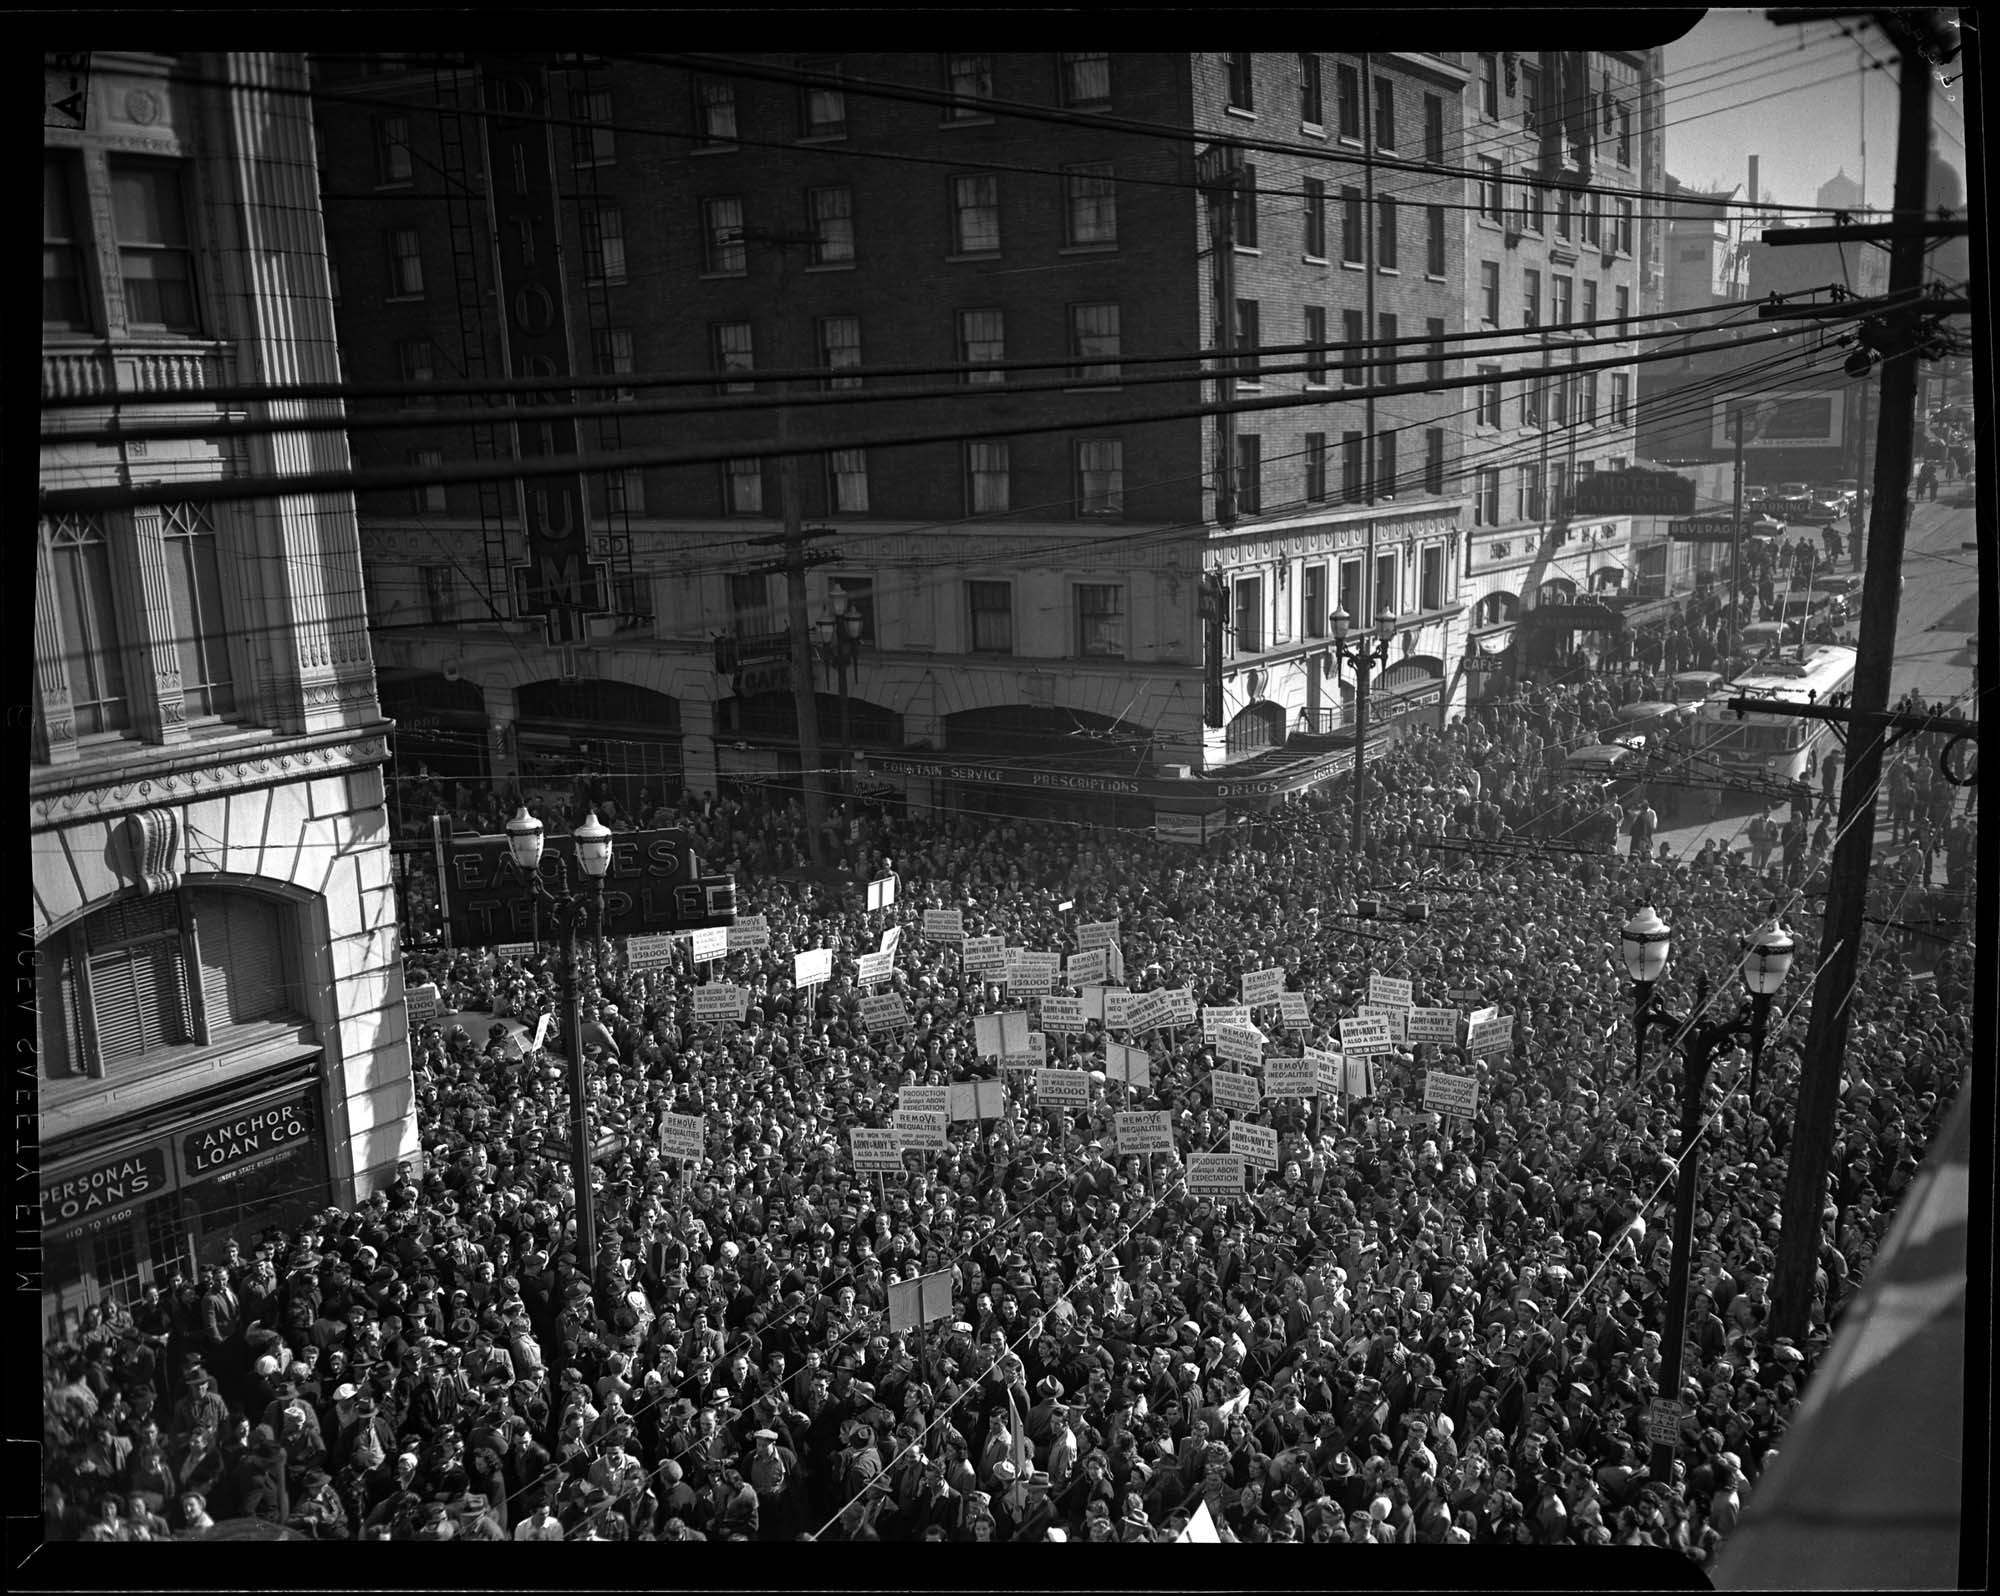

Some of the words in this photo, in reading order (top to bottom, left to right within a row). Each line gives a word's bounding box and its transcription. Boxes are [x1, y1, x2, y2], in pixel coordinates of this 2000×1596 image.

[1603, 476, 1665, 492] HOTEL
[1578, 494, 1680, 513] CALEDONIA
[1752, 501, 1806, 513] PARKING
[1671, 521, 1748, 535] BEVERAGS
[952, 766, 1004, 782] SERVICE
[1032, 773, 1139, 793] PRESCRIPTIONS
[1217, 782, 1279, 797] DRUGS
[454, 840, 679, 890] EAGES
[469, 885, 702, 937] TEPLE
[1072, 953, 1099, 964] REMOVE
[1248, 971, 1275, 983] REMOVE
[1223, 1027, 1253, 1040] REMOVE
[1272, 1061, 1309, 1070] REMOVE
[1431, 1076, 1474, 1089] PRODUCTION
[1429, 1091, 1471, 1104] EXPECTATION
[668, 1117, 696, 1128] REMOVE
[900, 1114, 937, 1123] REMOVE
[1123, 1111, 1161, 1124] REMOVE
[203, 1105, 293, 1150] ANCHOR
[664, 1127, 700, 1138] INEQUALITIES
[196, 1136, 259, 1170] LOAN
[271, 1120, 305, 1143] CO.
[40, 1158, 147, 1208] PERSONAL
[40, 1174, 150, 1226] LOANS
[88, 1220, 101, 1232] TO
